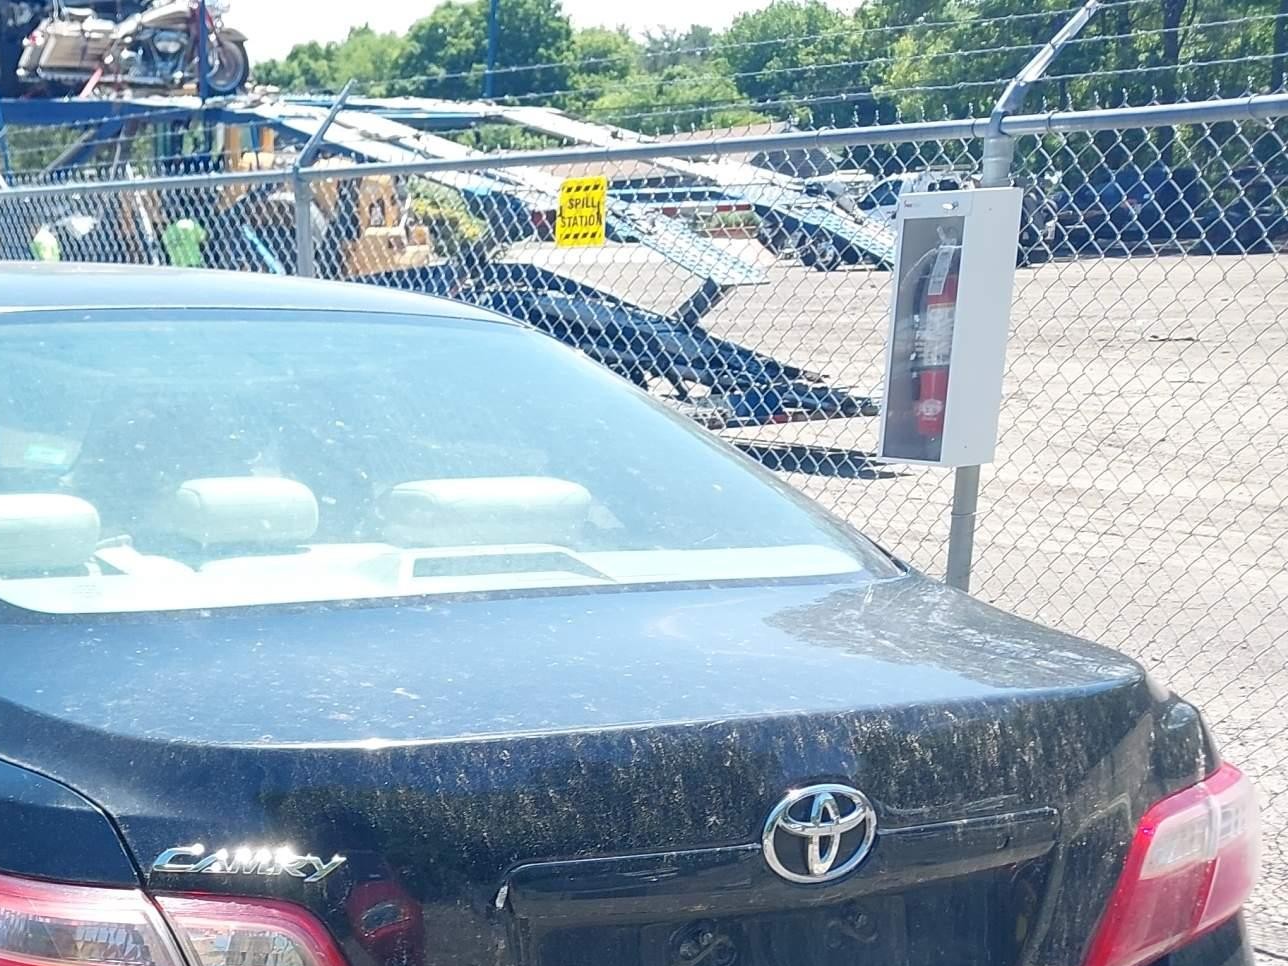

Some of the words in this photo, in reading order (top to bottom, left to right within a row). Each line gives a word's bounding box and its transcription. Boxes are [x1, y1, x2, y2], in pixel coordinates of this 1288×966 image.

[568, 196, 597, 210] SPILL
[560, 214, 603, 228] STATION
[152, 843, 347, 882] CAMRY
